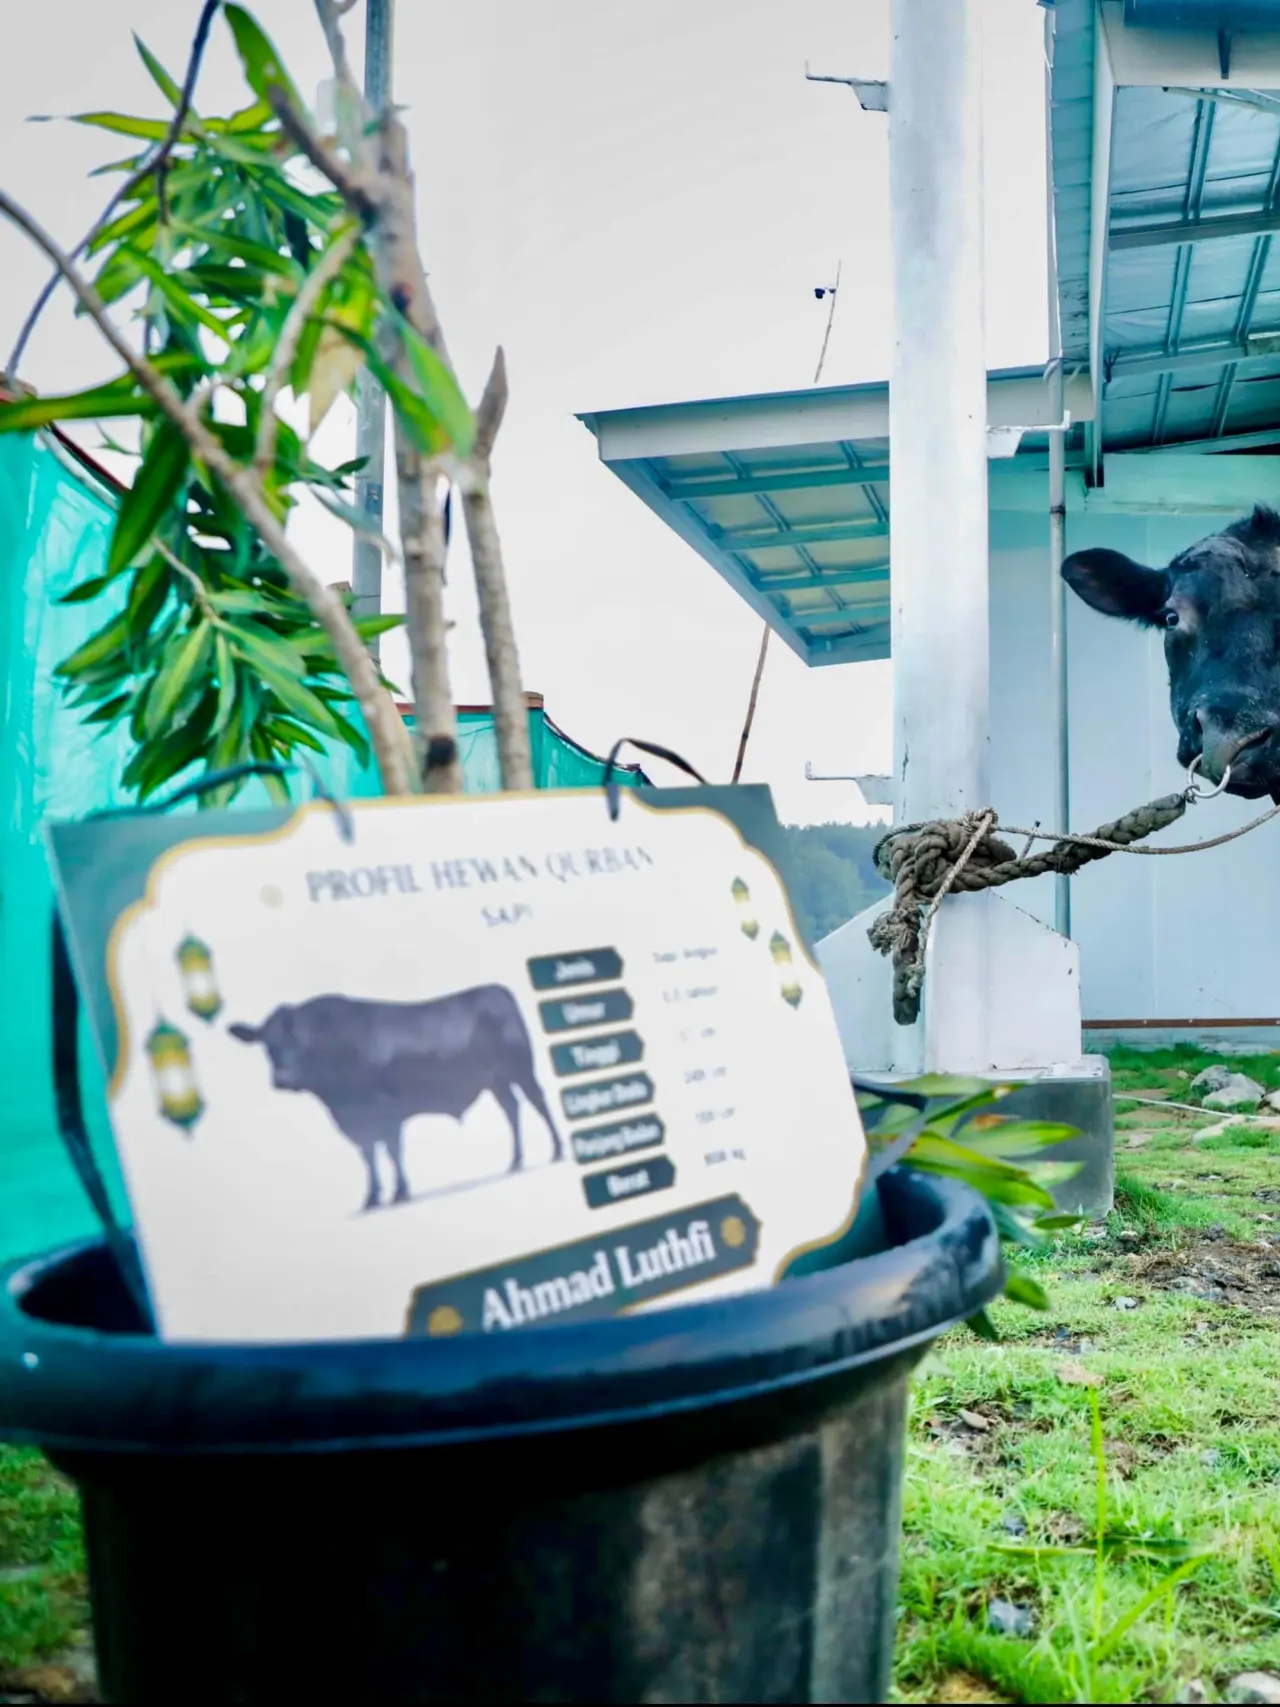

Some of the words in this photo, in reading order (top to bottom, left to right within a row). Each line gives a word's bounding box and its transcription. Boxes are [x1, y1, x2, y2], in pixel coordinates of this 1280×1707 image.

[305, 863, 423, 903] PROFIL
[430, 855, 538, 890] HEWAN
[545, 846, 655, 883] QURBAN
[482, 1250, 615, 1333] Ahmad
[614, 1220, 716, 1290] Luthfi
